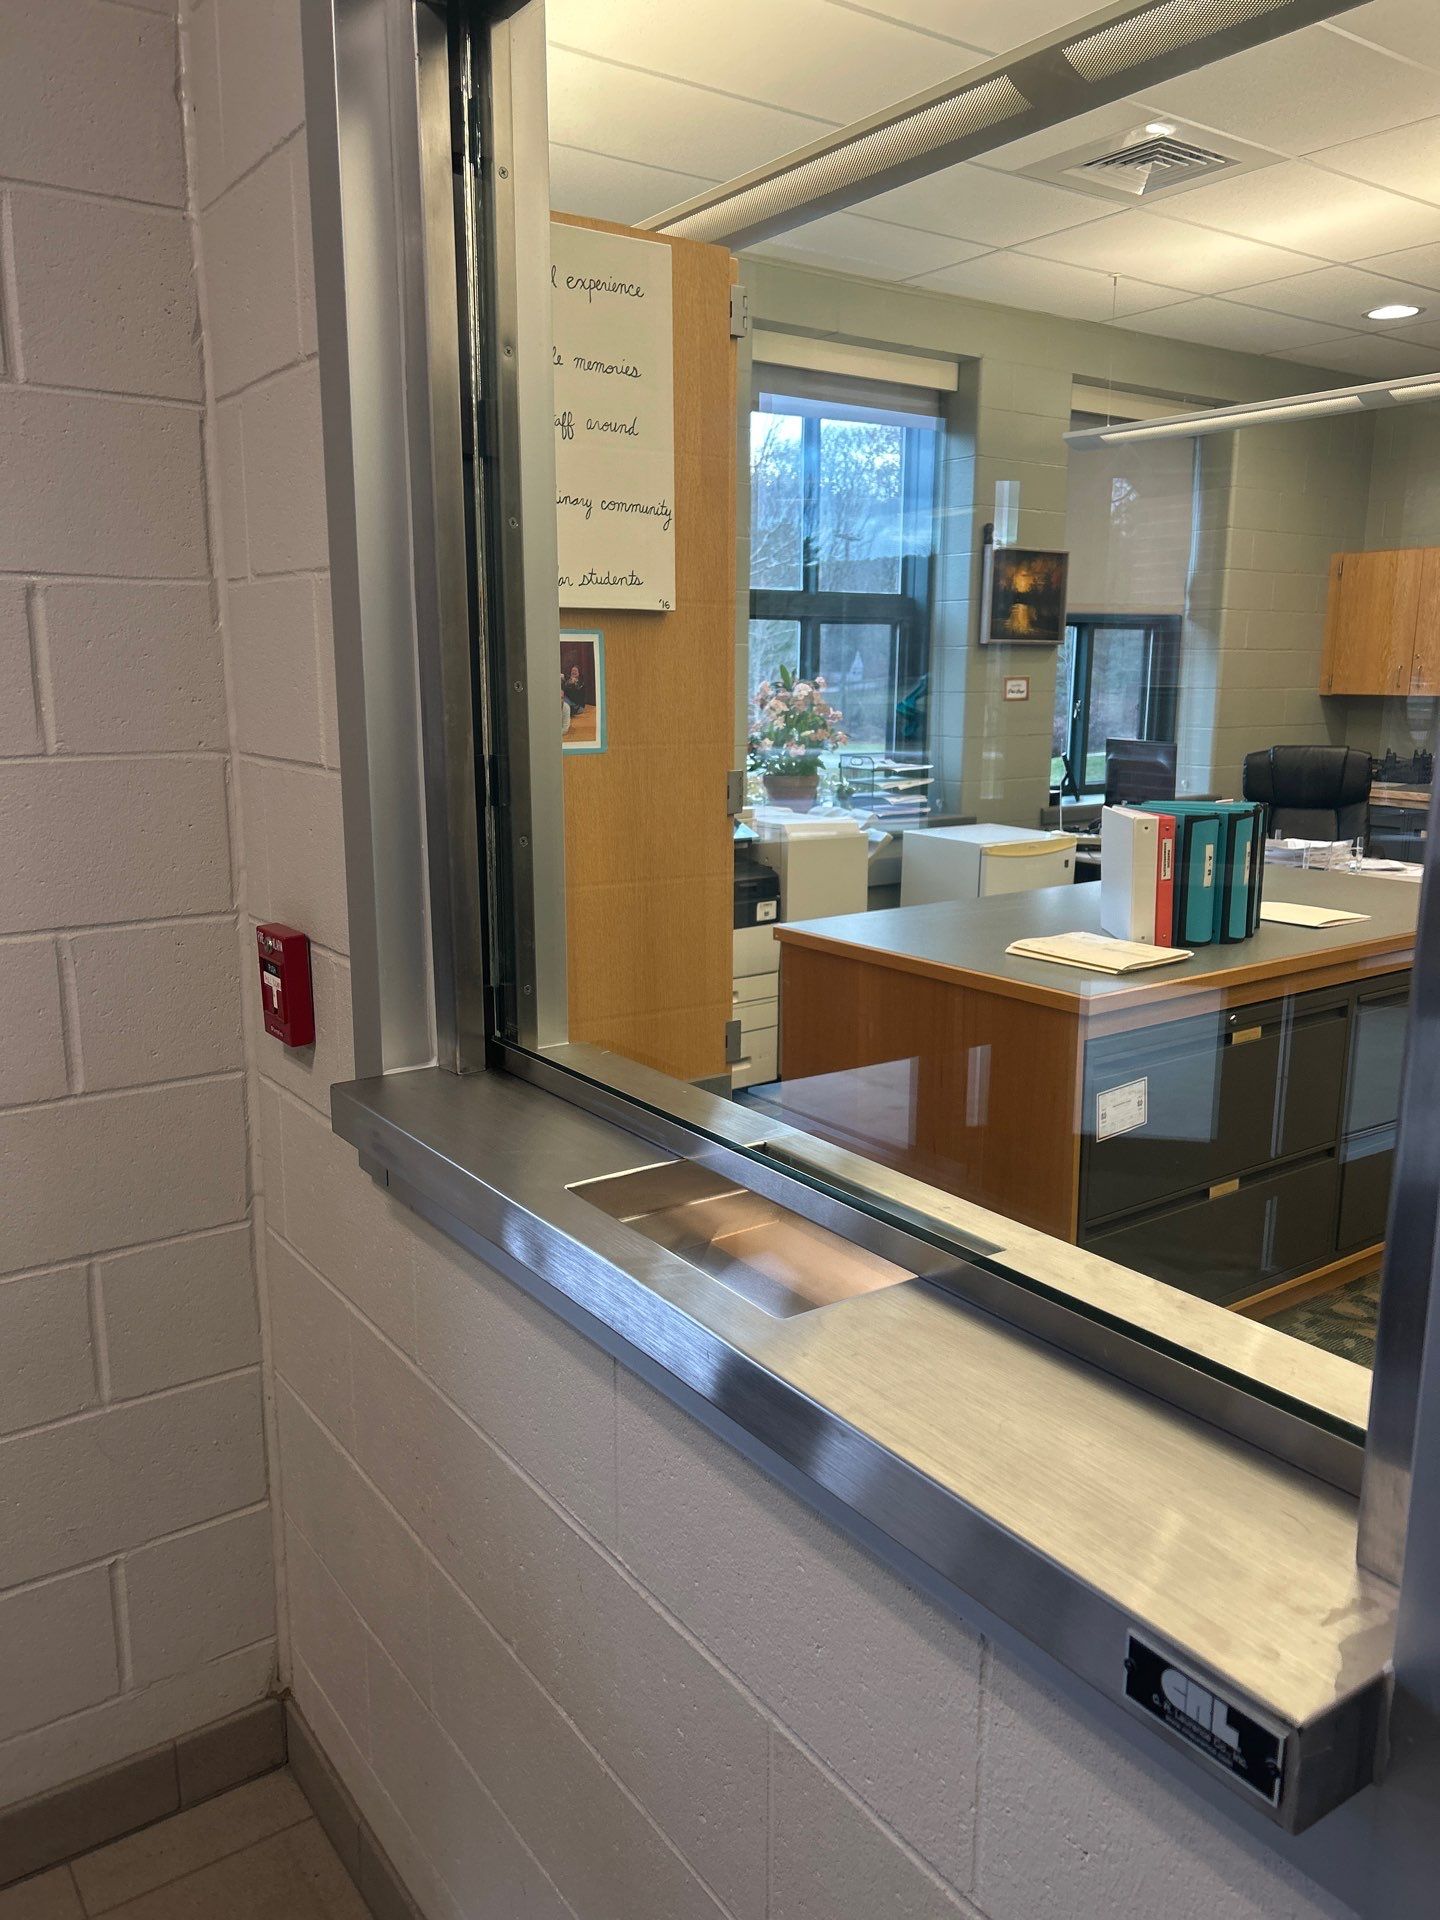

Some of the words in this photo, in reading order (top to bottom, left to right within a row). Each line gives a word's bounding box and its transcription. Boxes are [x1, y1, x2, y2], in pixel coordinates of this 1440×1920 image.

[566, 276, 645, 303] experience
[573, 356, 642, 378] memories
[554, 411, 576, 440] aff
[586, 416, 639, 436] around
[556, 489, 593, 520] inary
[600, 499, 673, 531] community
[578, 567, 644, 587] students
[658, 598, 671, 610] '16
